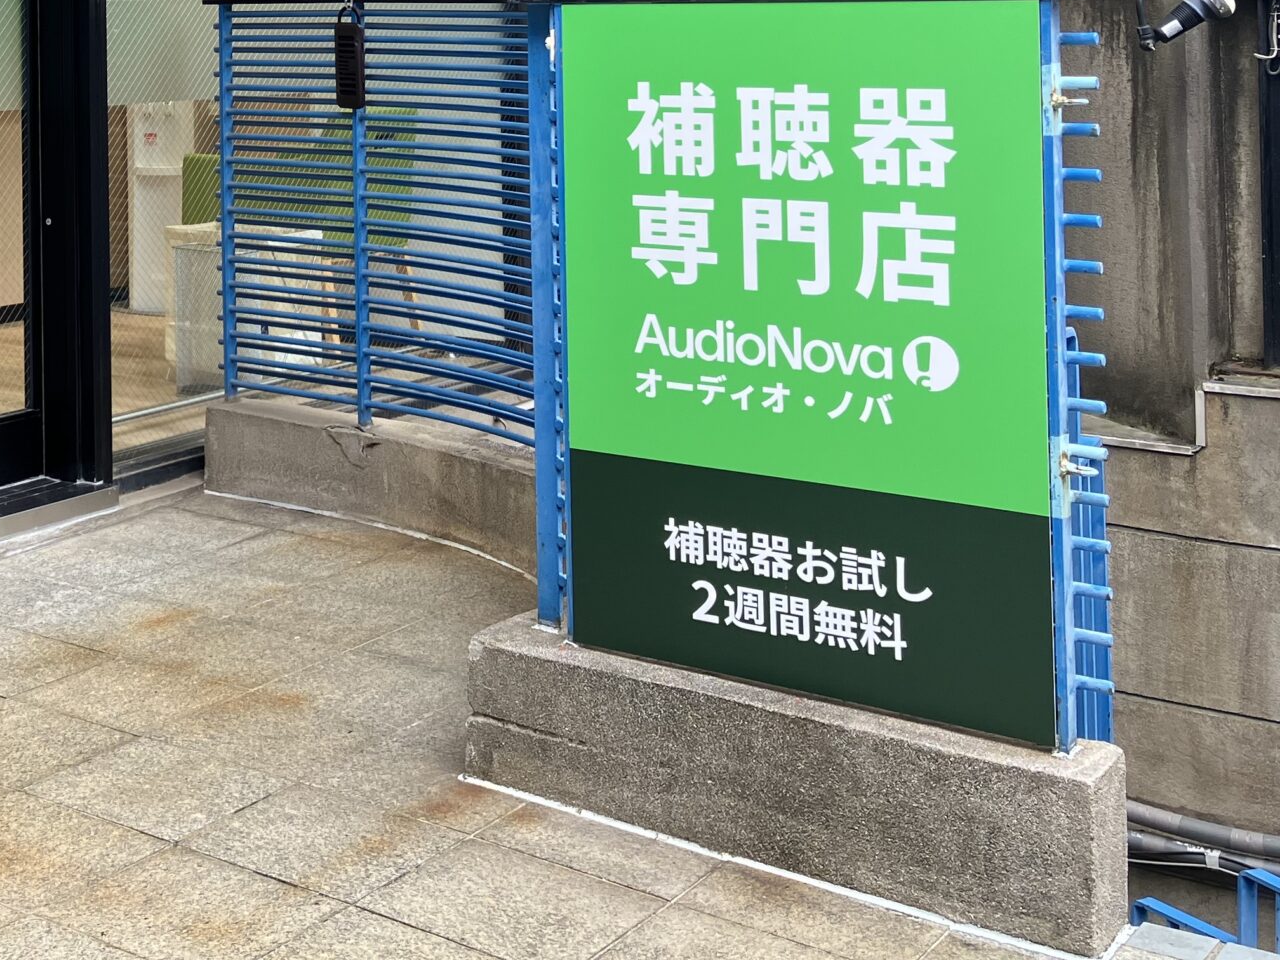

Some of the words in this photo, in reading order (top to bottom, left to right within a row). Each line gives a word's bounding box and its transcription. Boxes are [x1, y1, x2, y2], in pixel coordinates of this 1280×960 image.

[627, 81, 957, 187] 補聴器
[631, 190, 956, 306] 専門店
[634, 313, 893, 380] AudioNova
[635, 368, 894, 425] オーディオ・ノバ
[664, 517, 933, 602] 補聴器お試し
[691, 579, 907, 661] 2週間無料
